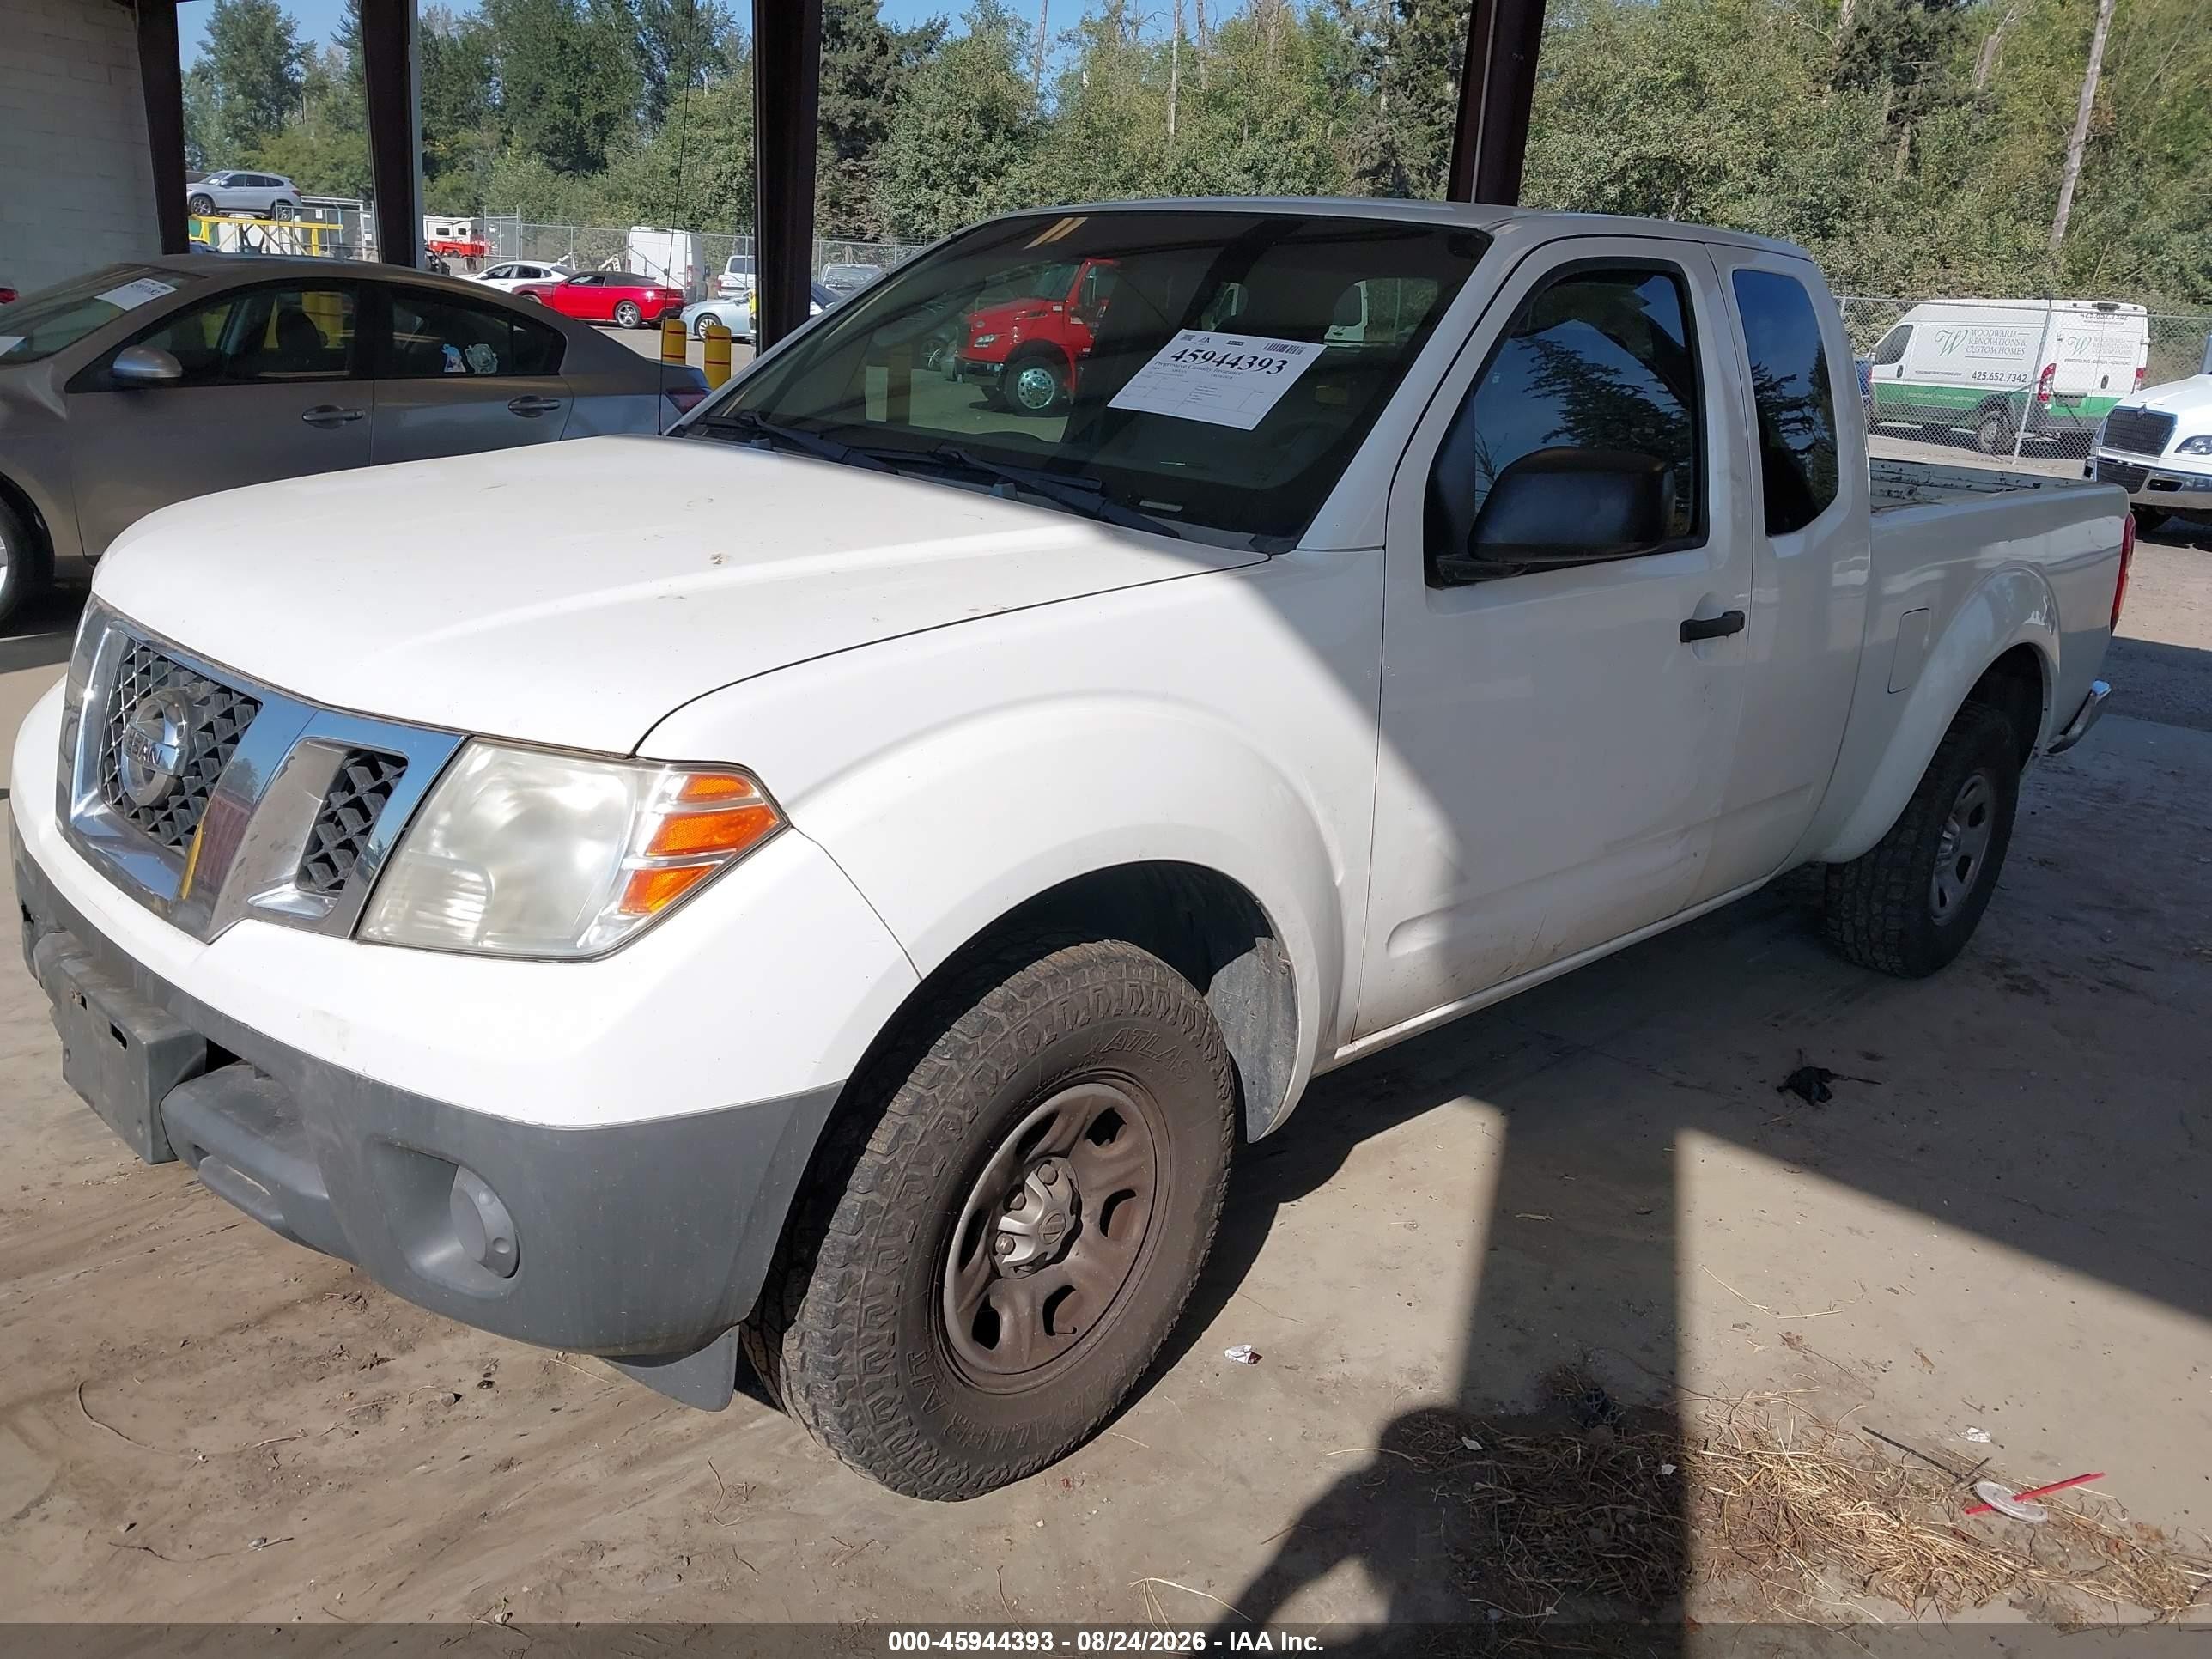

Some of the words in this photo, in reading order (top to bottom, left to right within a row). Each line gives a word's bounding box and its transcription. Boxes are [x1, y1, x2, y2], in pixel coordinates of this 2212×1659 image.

[1972, 329, 2017, 337] WOODWARD
[1935, 329, 1968, 356] W
[1968, 337, 2019, 346] RENOVATIONS
[1966, 345, 1997, 355] CUSTOM
[1998, 347, 2026, 356] HOMES
[1170, 348, 1288, 374] 45944393
[1972, 370, 2027, 383] 425.652.7342
[1099, 1027, 1190, 1085] ATLAS
